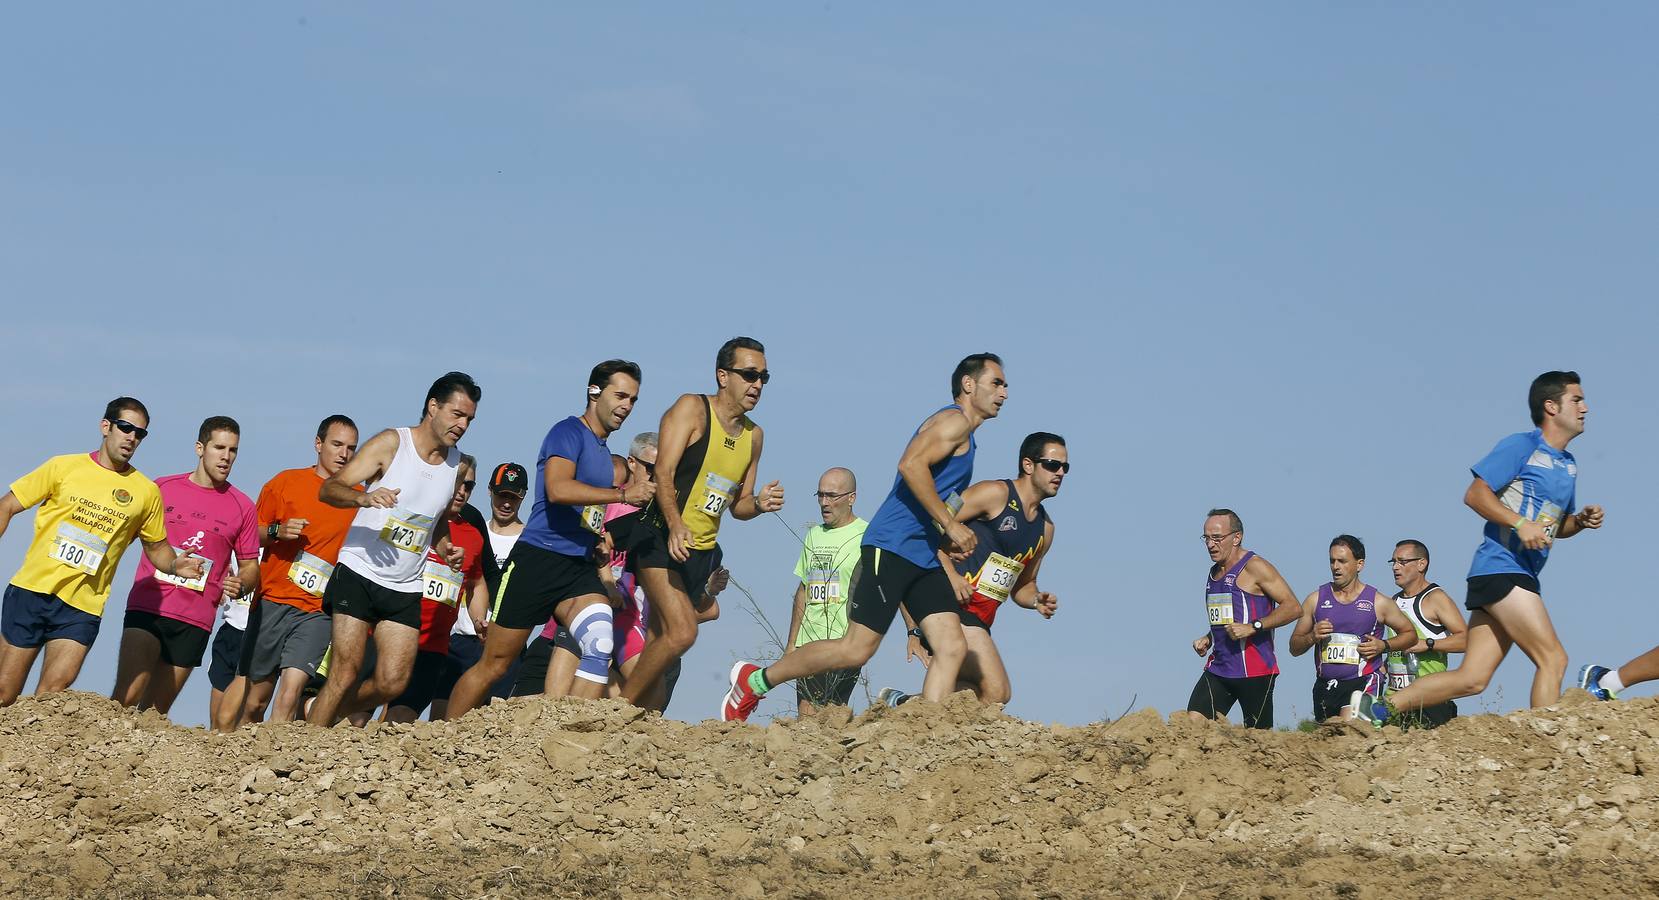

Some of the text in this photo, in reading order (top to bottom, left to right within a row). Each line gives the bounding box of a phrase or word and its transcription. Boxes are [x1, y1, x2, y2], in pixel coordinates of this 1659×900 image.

[76, 506, 116, 526] MUNICIPAL
[79, 497, 101, 510] CROSS
[103, 507, 129, 521] POLICIA
[391, 526, 414, 546] 173
[60, 543, 83, 564] 180
[299, 571, 317, 588] 56
[427, 580, 443, 598] 50
[1327, 647, 1345, 660] 204
